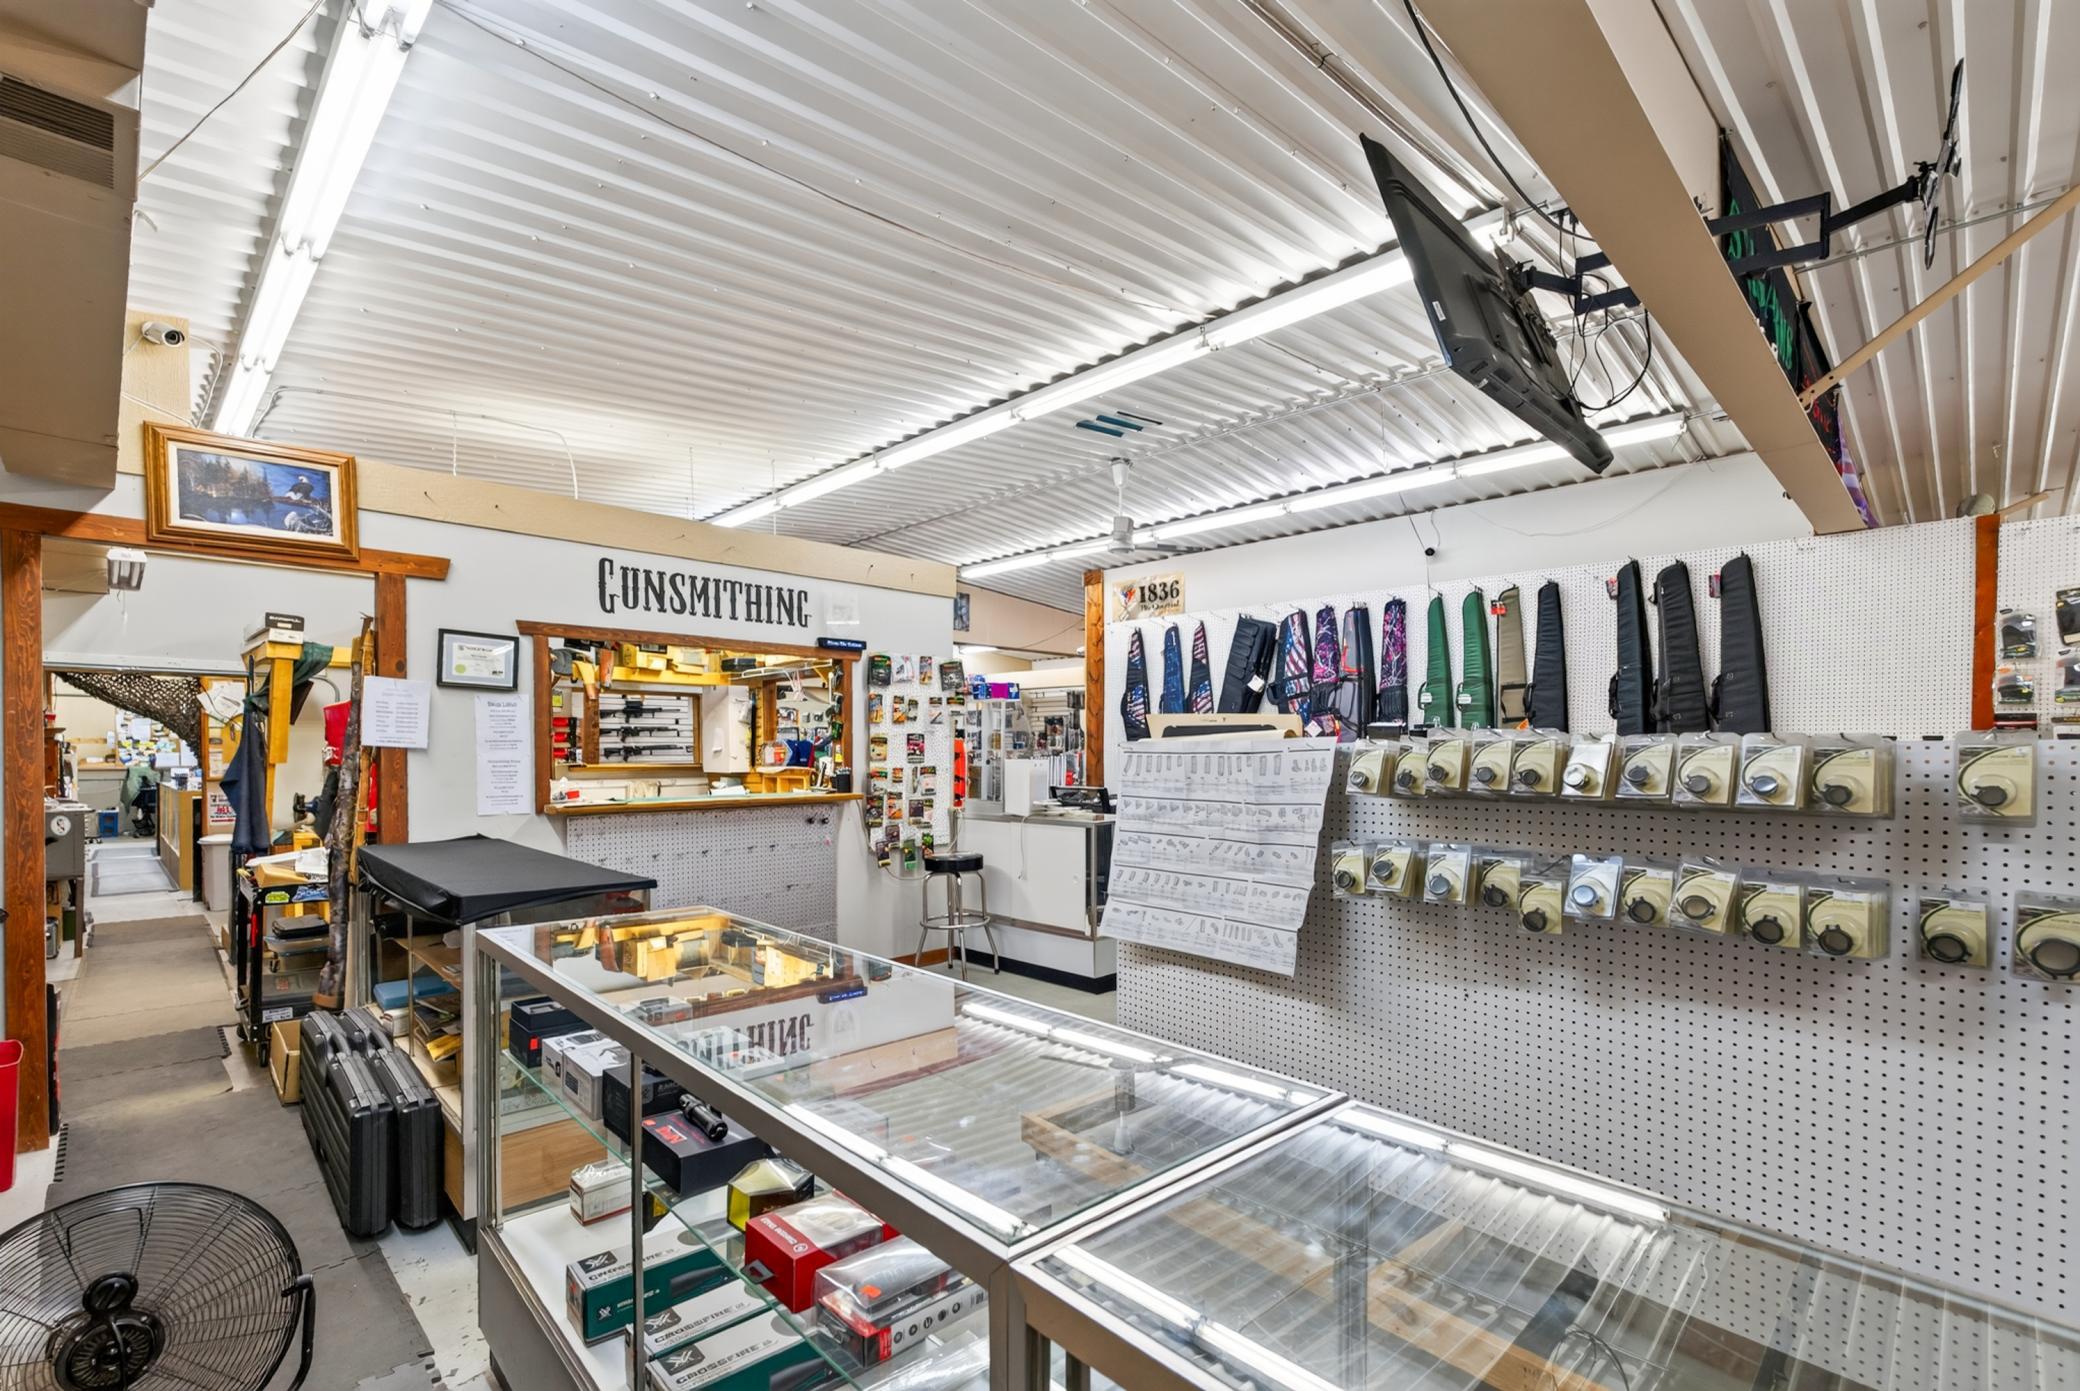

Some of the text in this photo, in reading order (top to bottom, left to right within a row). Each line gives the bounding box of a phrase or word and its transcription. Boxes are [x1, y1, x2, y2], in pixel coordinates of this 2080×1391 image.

[597, 557, 812, 628] GUNSMITHING
[1138, 580, 1180, 603] 1836
[676, 1344, 760, 1385] CROSSFIRE
